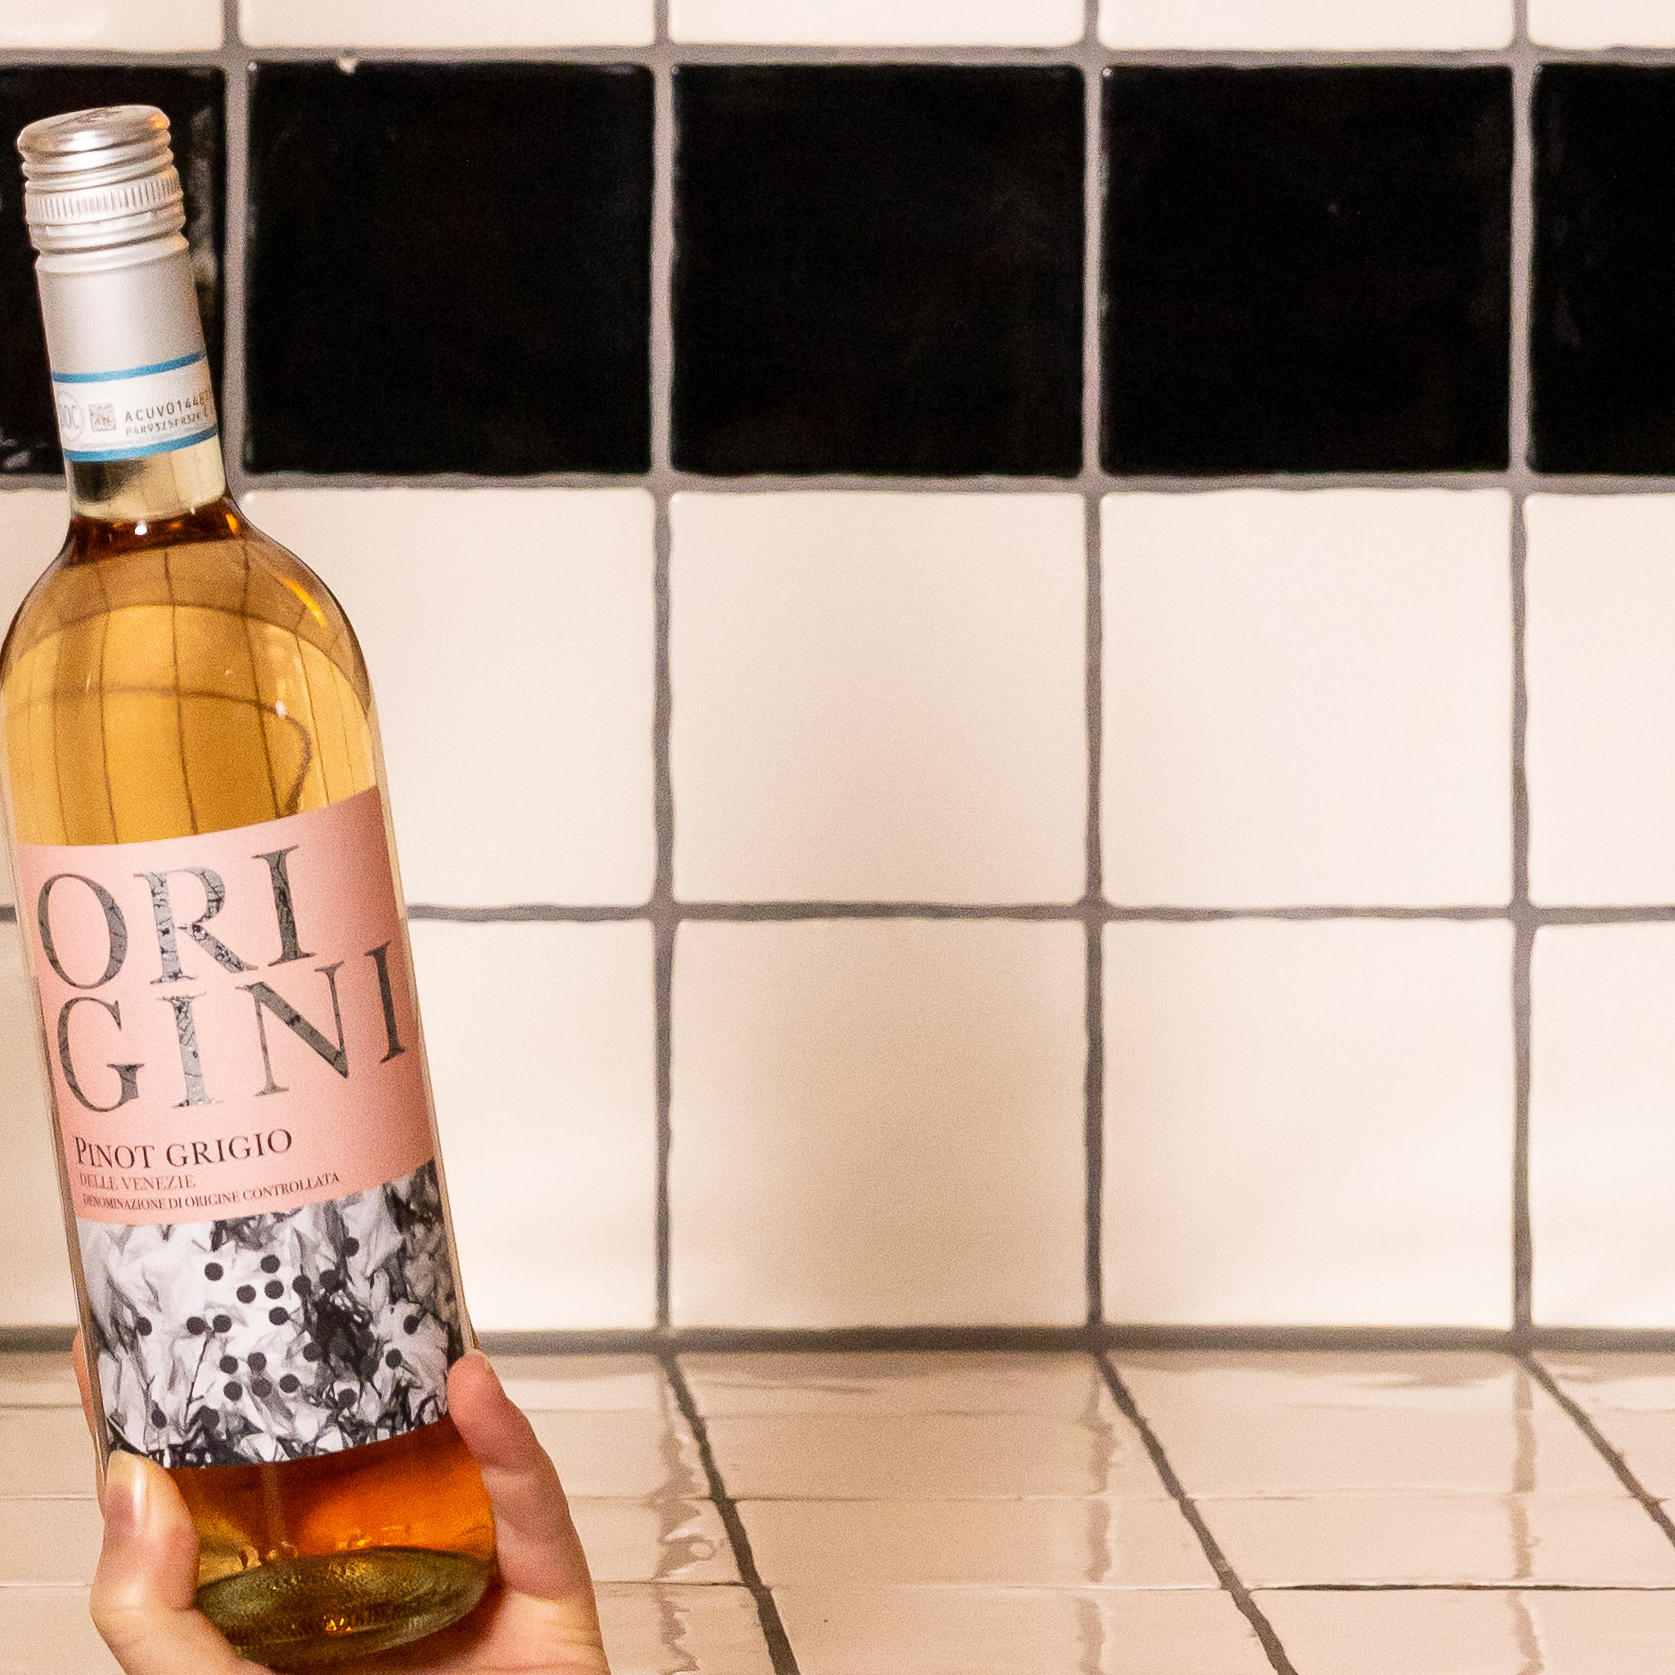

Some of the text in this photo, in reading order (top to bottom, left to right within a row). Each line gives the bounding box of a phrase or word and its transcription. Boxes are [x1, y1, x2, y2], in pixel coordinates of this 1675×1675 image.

[37, 844, 316, 990] ORI
[57, 940, 406, 1113] GINI
[73, 1128, 293, 1169] PINOT GRIGIO
[79, 1172, 196, 1192] DELLE VENEZIE
[83, 1171, 341, 1211] DENOMINAZIONE DI ORIGINE CONTROLLATA
